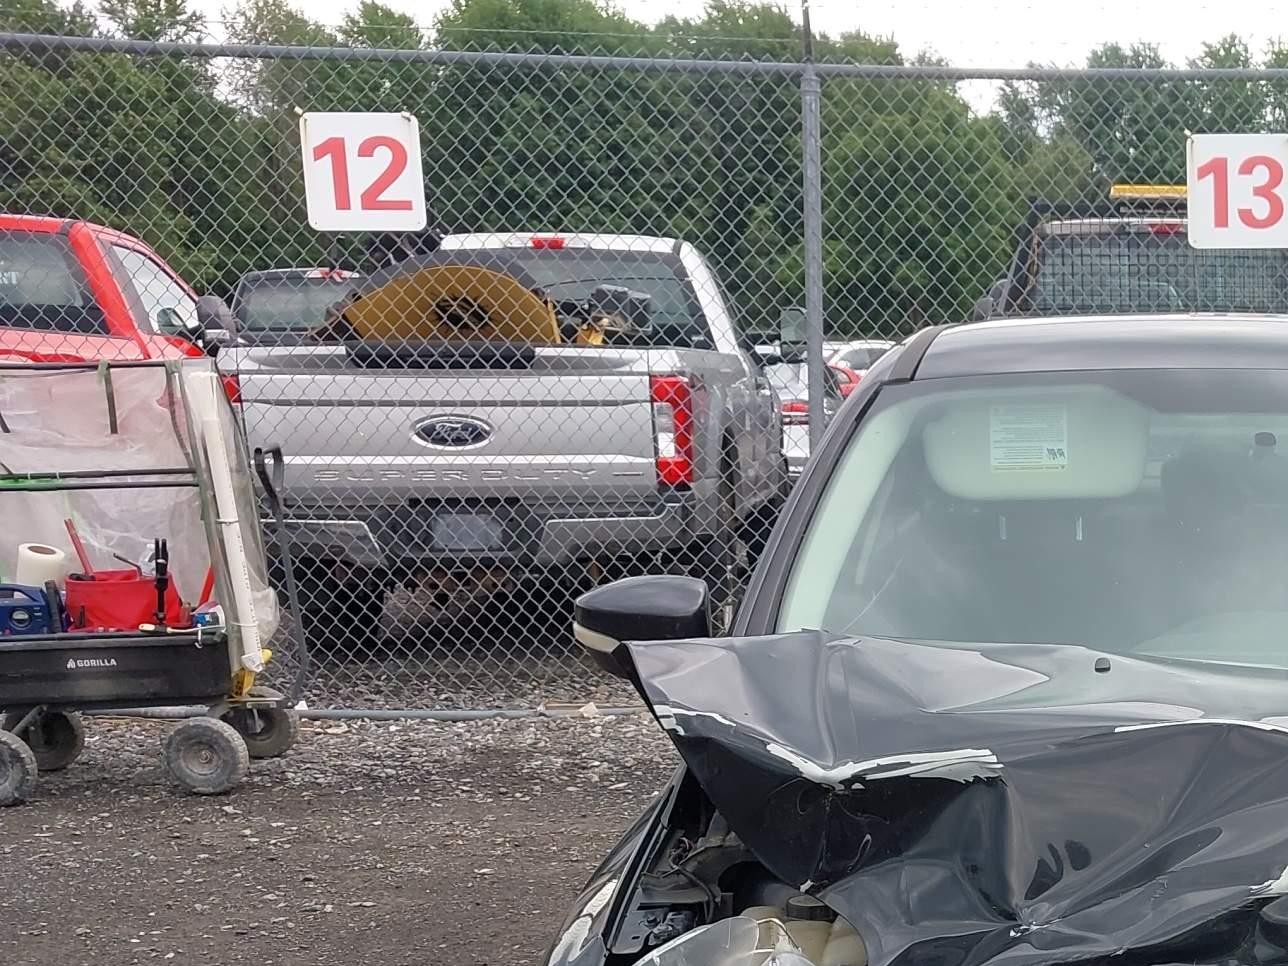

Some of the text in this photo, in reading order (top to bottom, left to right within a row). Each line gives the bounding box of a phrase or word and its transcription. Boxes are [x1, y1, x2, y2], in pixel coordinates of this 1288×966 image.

[313, 136, 413, 210] 12
[1197, 156, 1285, 229] 13
[76, 658, 118, 667] GORILLA
